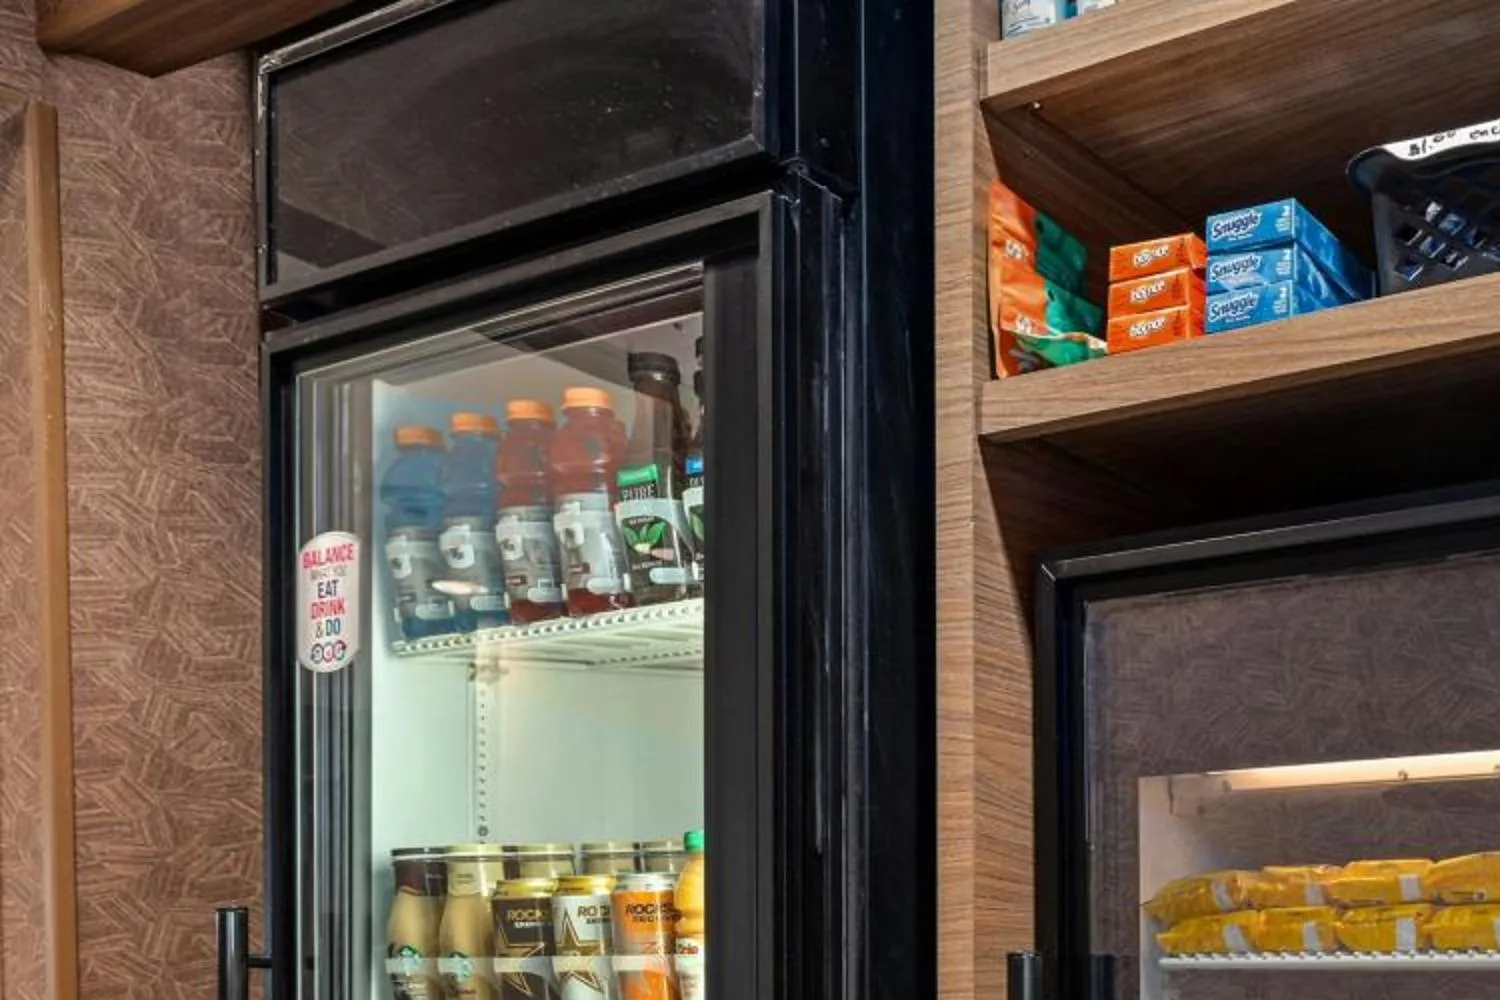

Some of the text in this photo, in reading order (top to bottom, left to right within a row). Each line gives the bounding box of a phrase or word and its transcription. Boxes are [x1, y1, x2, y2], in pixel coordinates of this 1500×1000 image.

[1213, 210, 1259, 238] Snuggle
[303, 543, 355, 569] BALANCE
[317, 580, 338, 598] EAT
[311, 598, 346, 620] DRINK
[325, 618, 341, 636] DO
